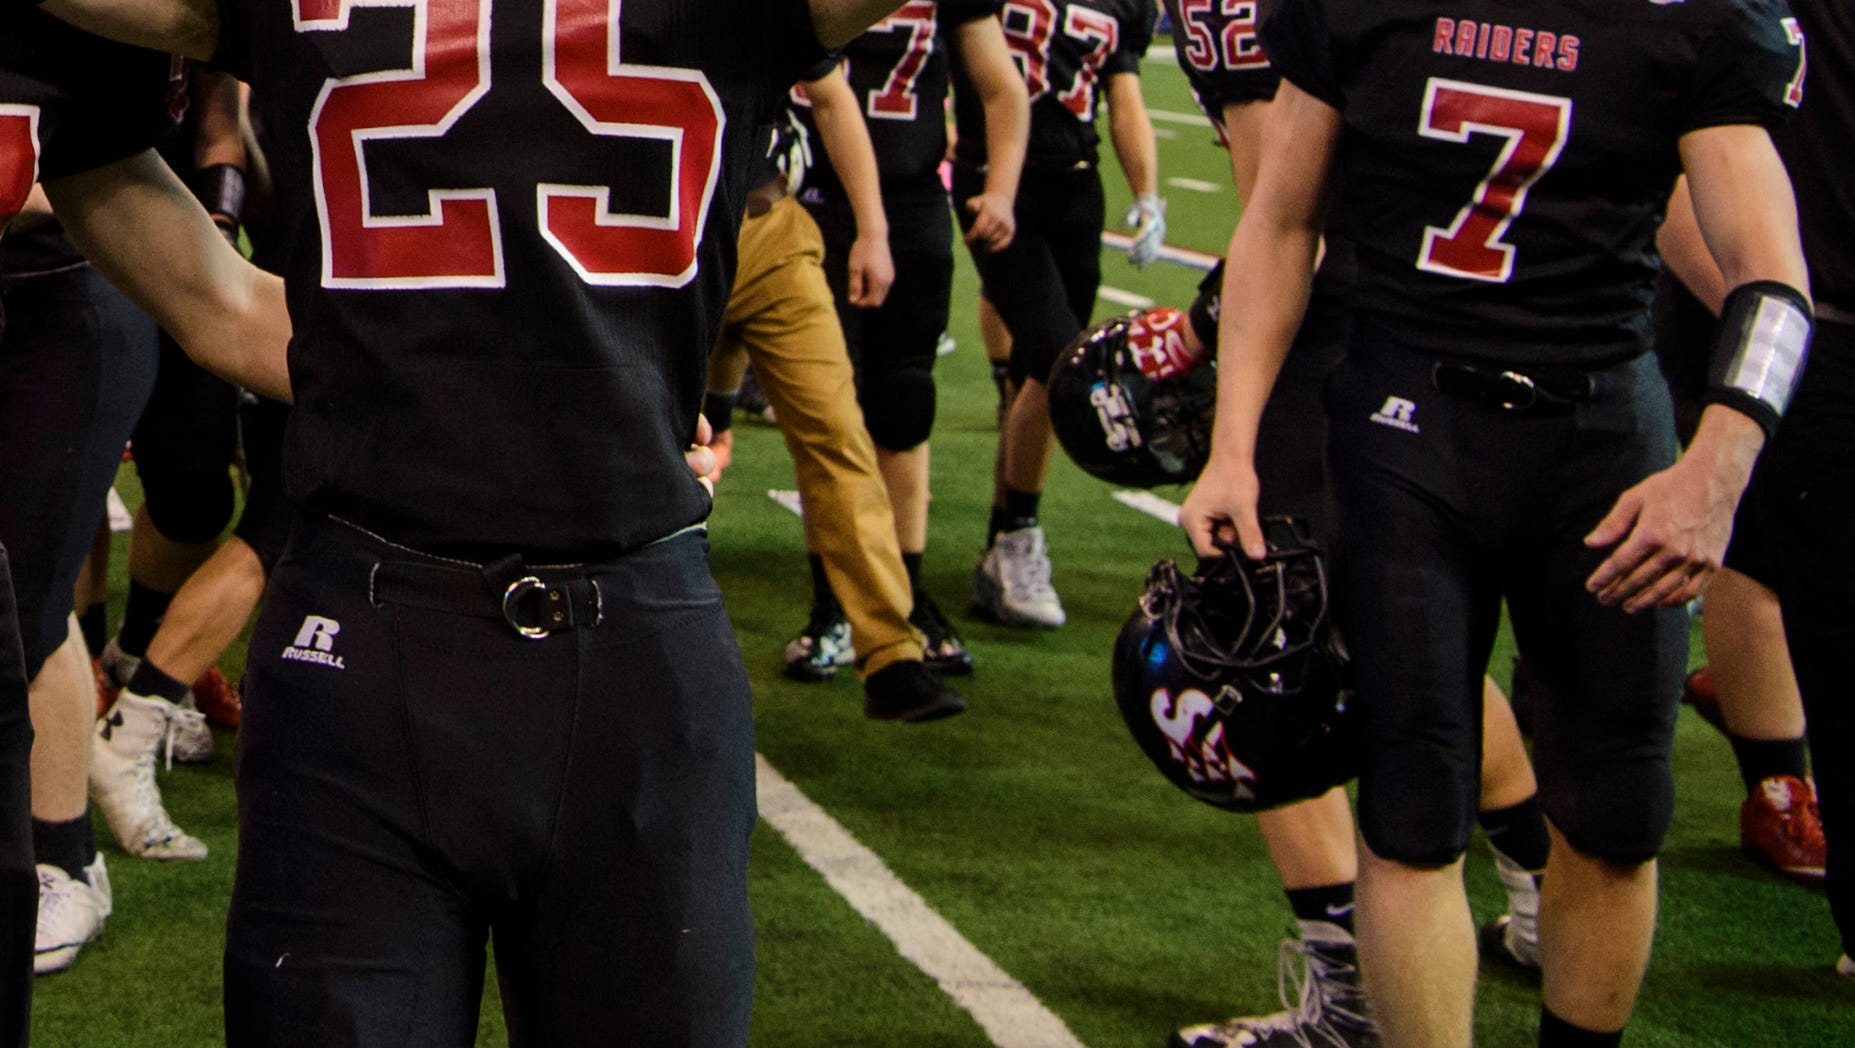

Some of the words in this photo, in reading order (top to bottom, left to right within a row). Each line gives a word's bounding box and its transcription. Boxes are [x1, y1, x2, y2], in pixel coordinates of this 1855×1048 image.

[1432, 17, 1581, 72] RAIDERS
[1415, 77, 1573, 284] 7
[281, 646, 345, 670] RUSSELL
